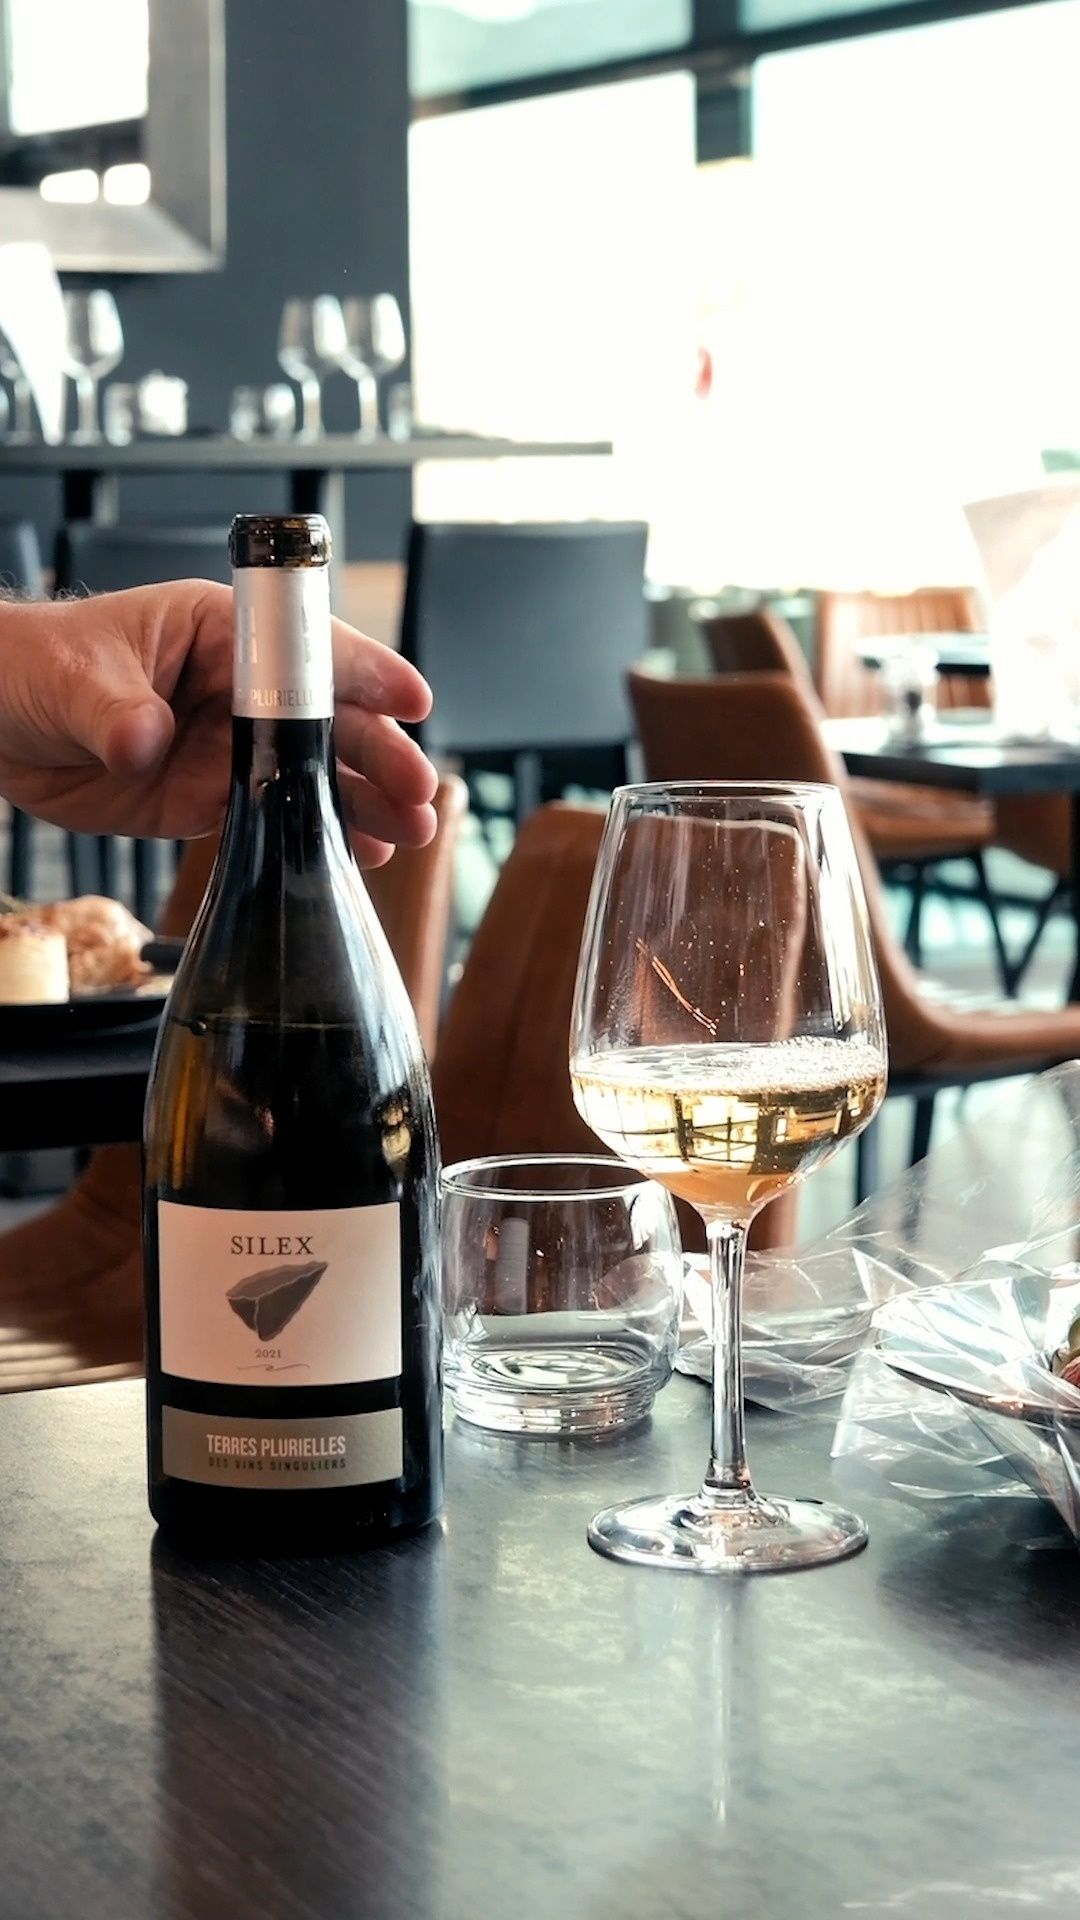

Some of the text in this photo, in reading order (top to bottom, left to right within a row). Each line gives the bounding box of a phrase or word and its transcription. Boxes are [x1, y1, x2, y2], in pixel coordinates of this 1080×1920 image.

[230, 1235, 314, 1255] SILEX
[255, 1348, 281, 1359] 2021
[206, 1434, 346, 1457] TERRES PLURIELLES
[209, 1457, 347, 1471] DES VINS SINGULIERS
